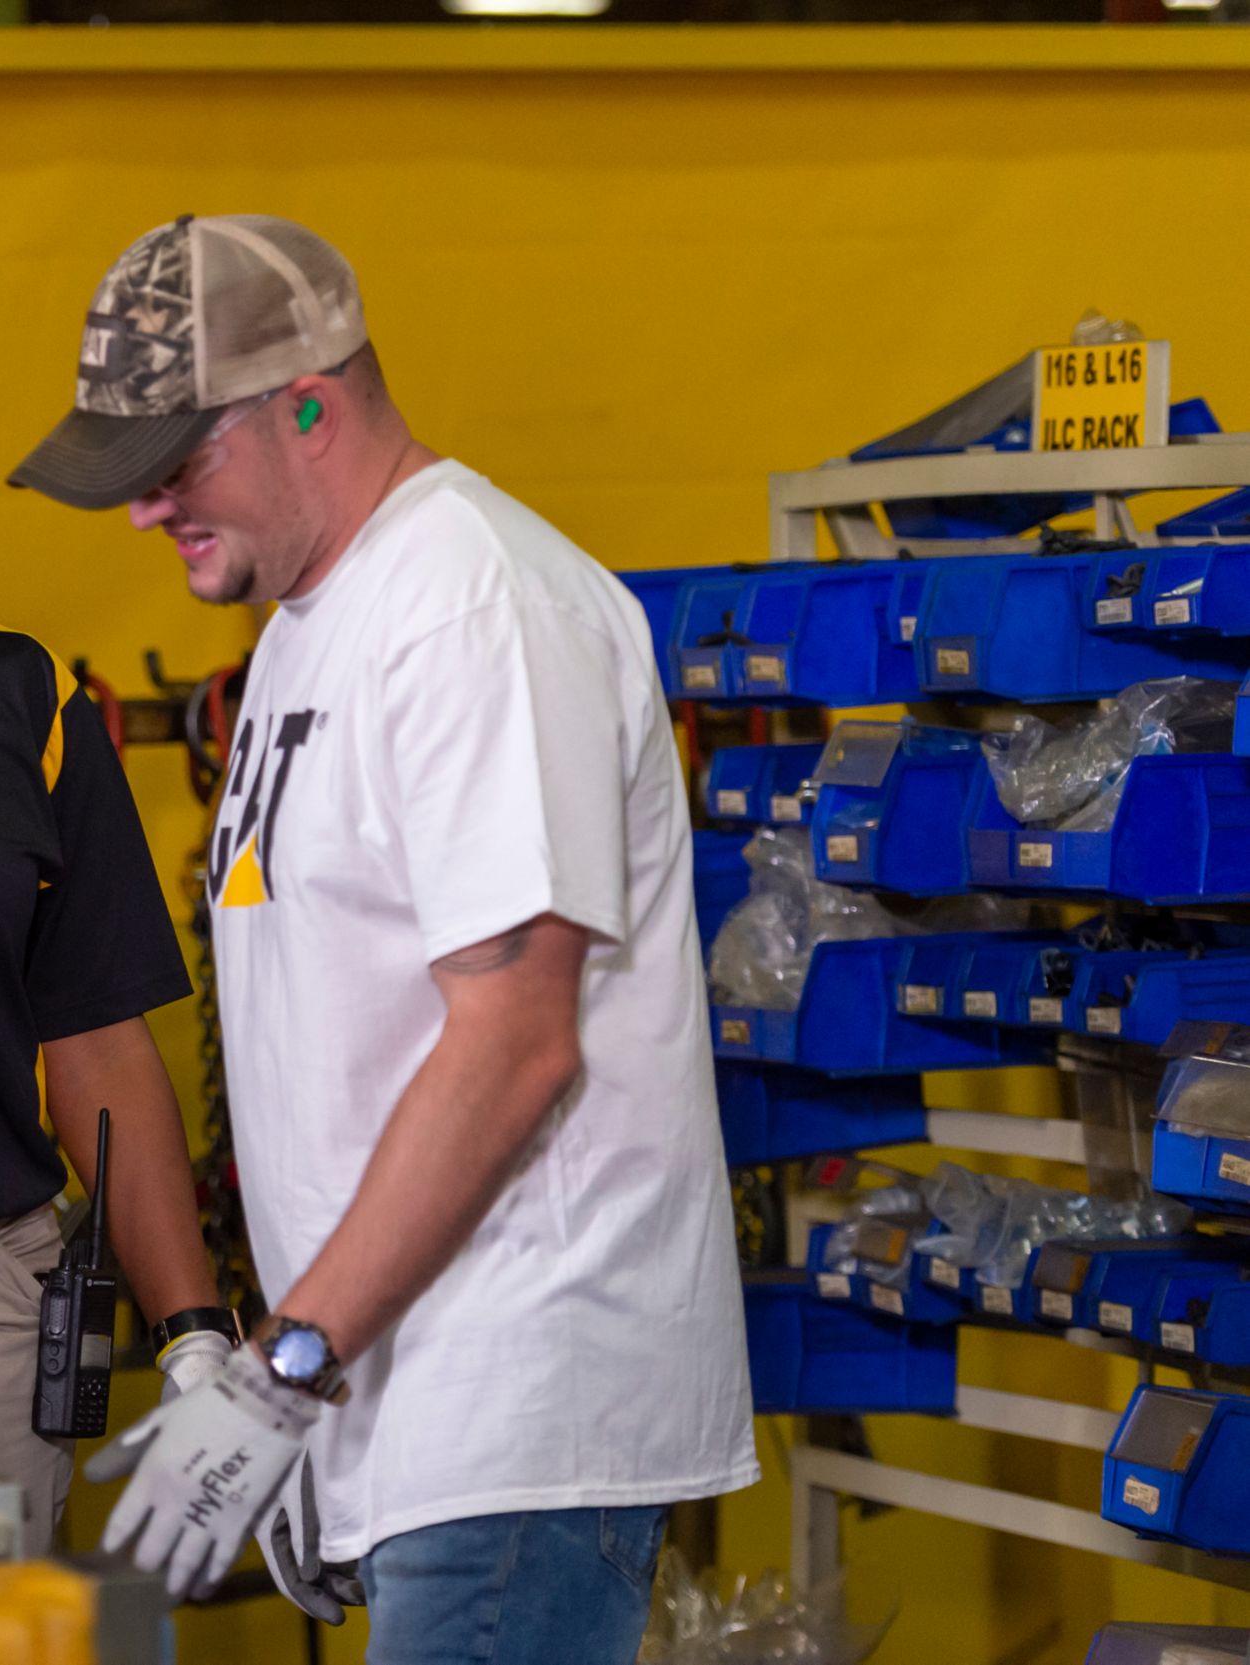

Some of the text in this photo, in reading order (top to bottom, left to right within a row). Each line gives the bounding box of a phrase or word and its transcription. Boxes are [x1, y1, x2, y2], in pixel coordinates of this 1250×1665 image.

[1083, 352, 1097, 386] &
[1105, 348, 1142, 383] L16
[1083, 414, 1139, 450] RACK
[185, 1449, 253, 1528] HyFlex
